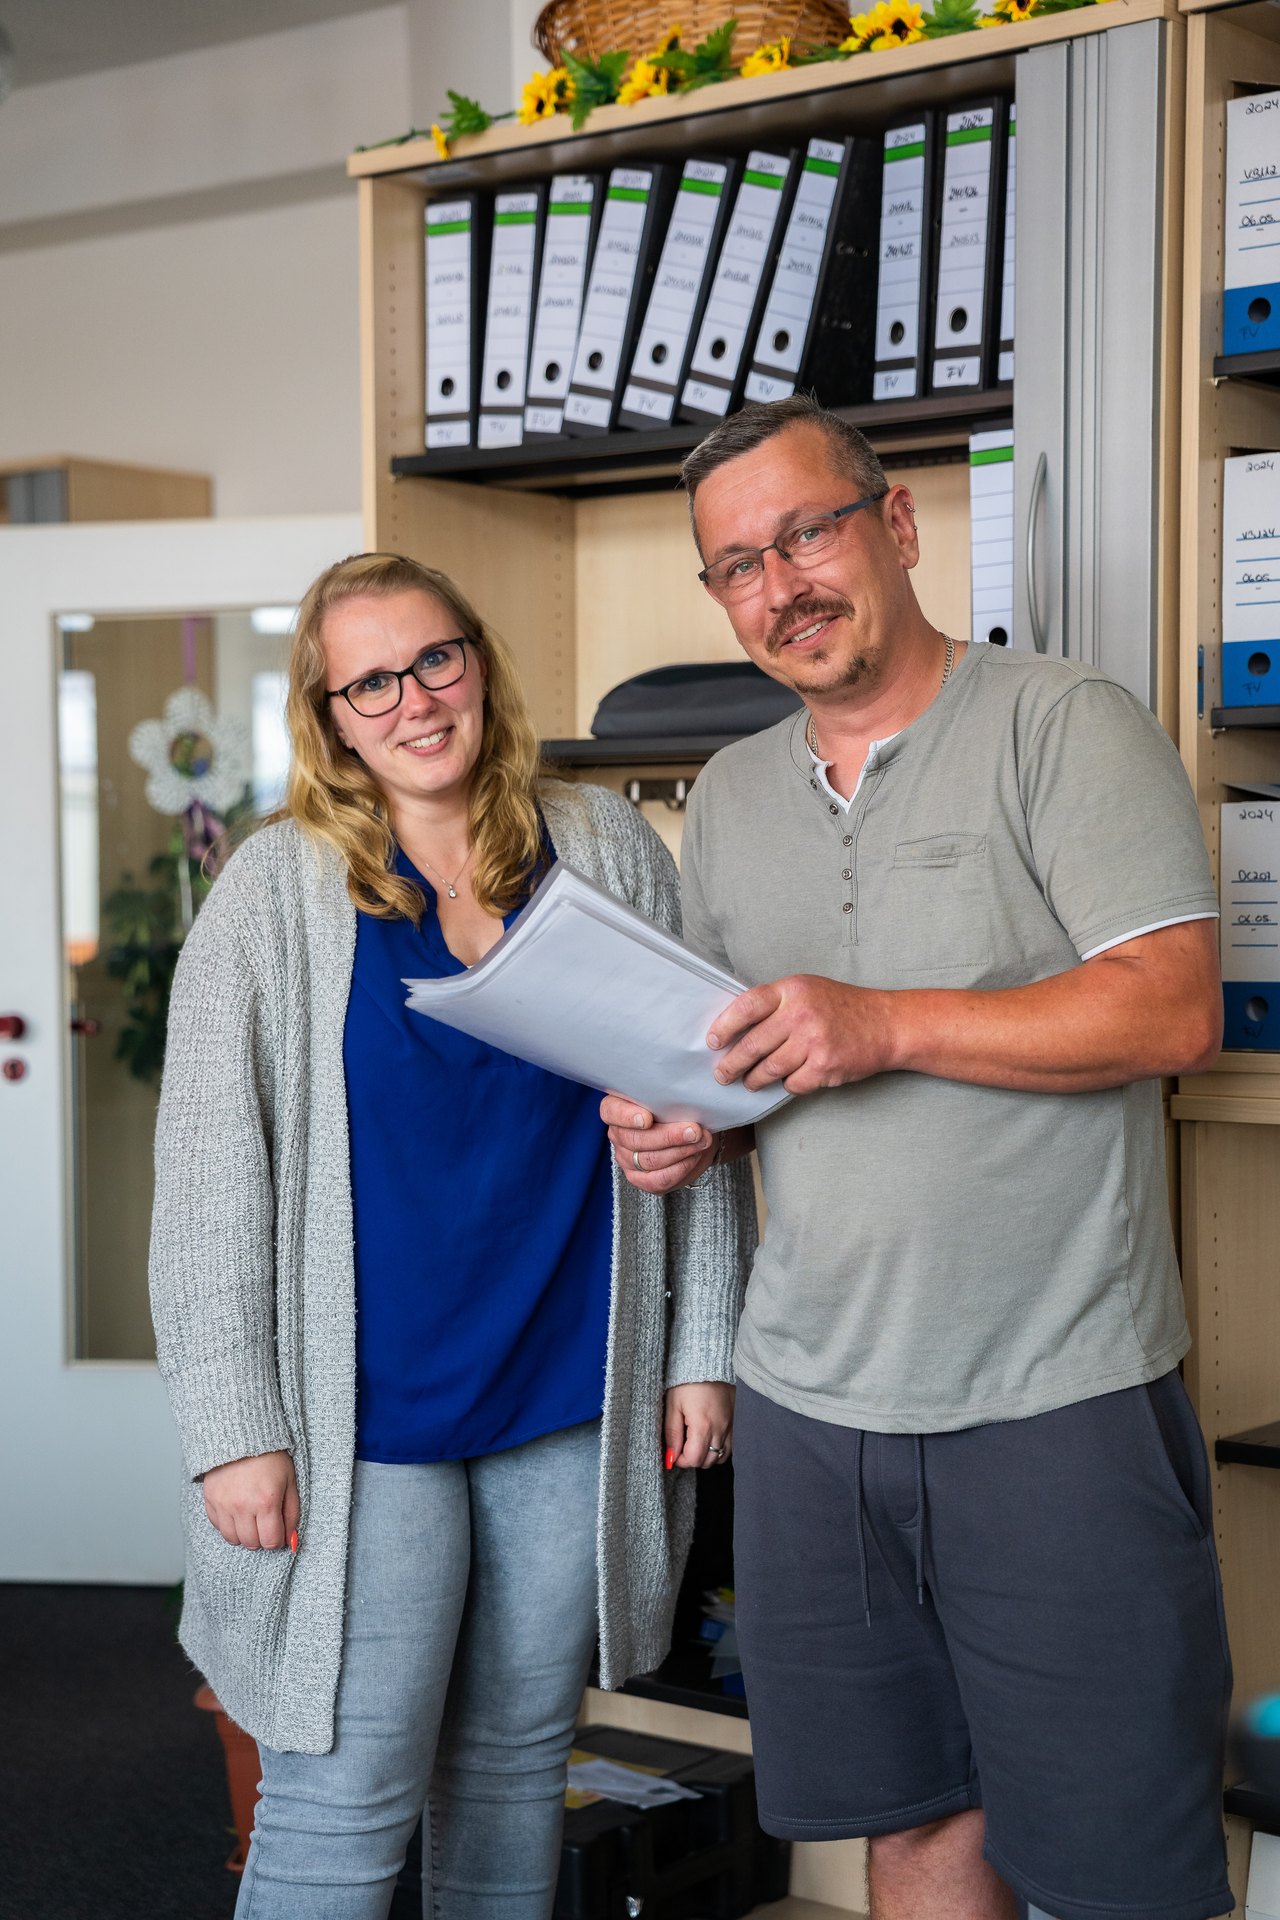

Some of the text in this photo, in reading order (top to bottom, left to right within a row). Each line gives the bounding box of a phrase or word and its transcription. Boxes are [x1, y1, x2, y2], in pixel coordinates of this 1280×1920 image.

[1245, 98, 1280, 115] 2024
[1245, 459, 1275, 473] 2024
[1239, 808, 1274, 823] 2024
